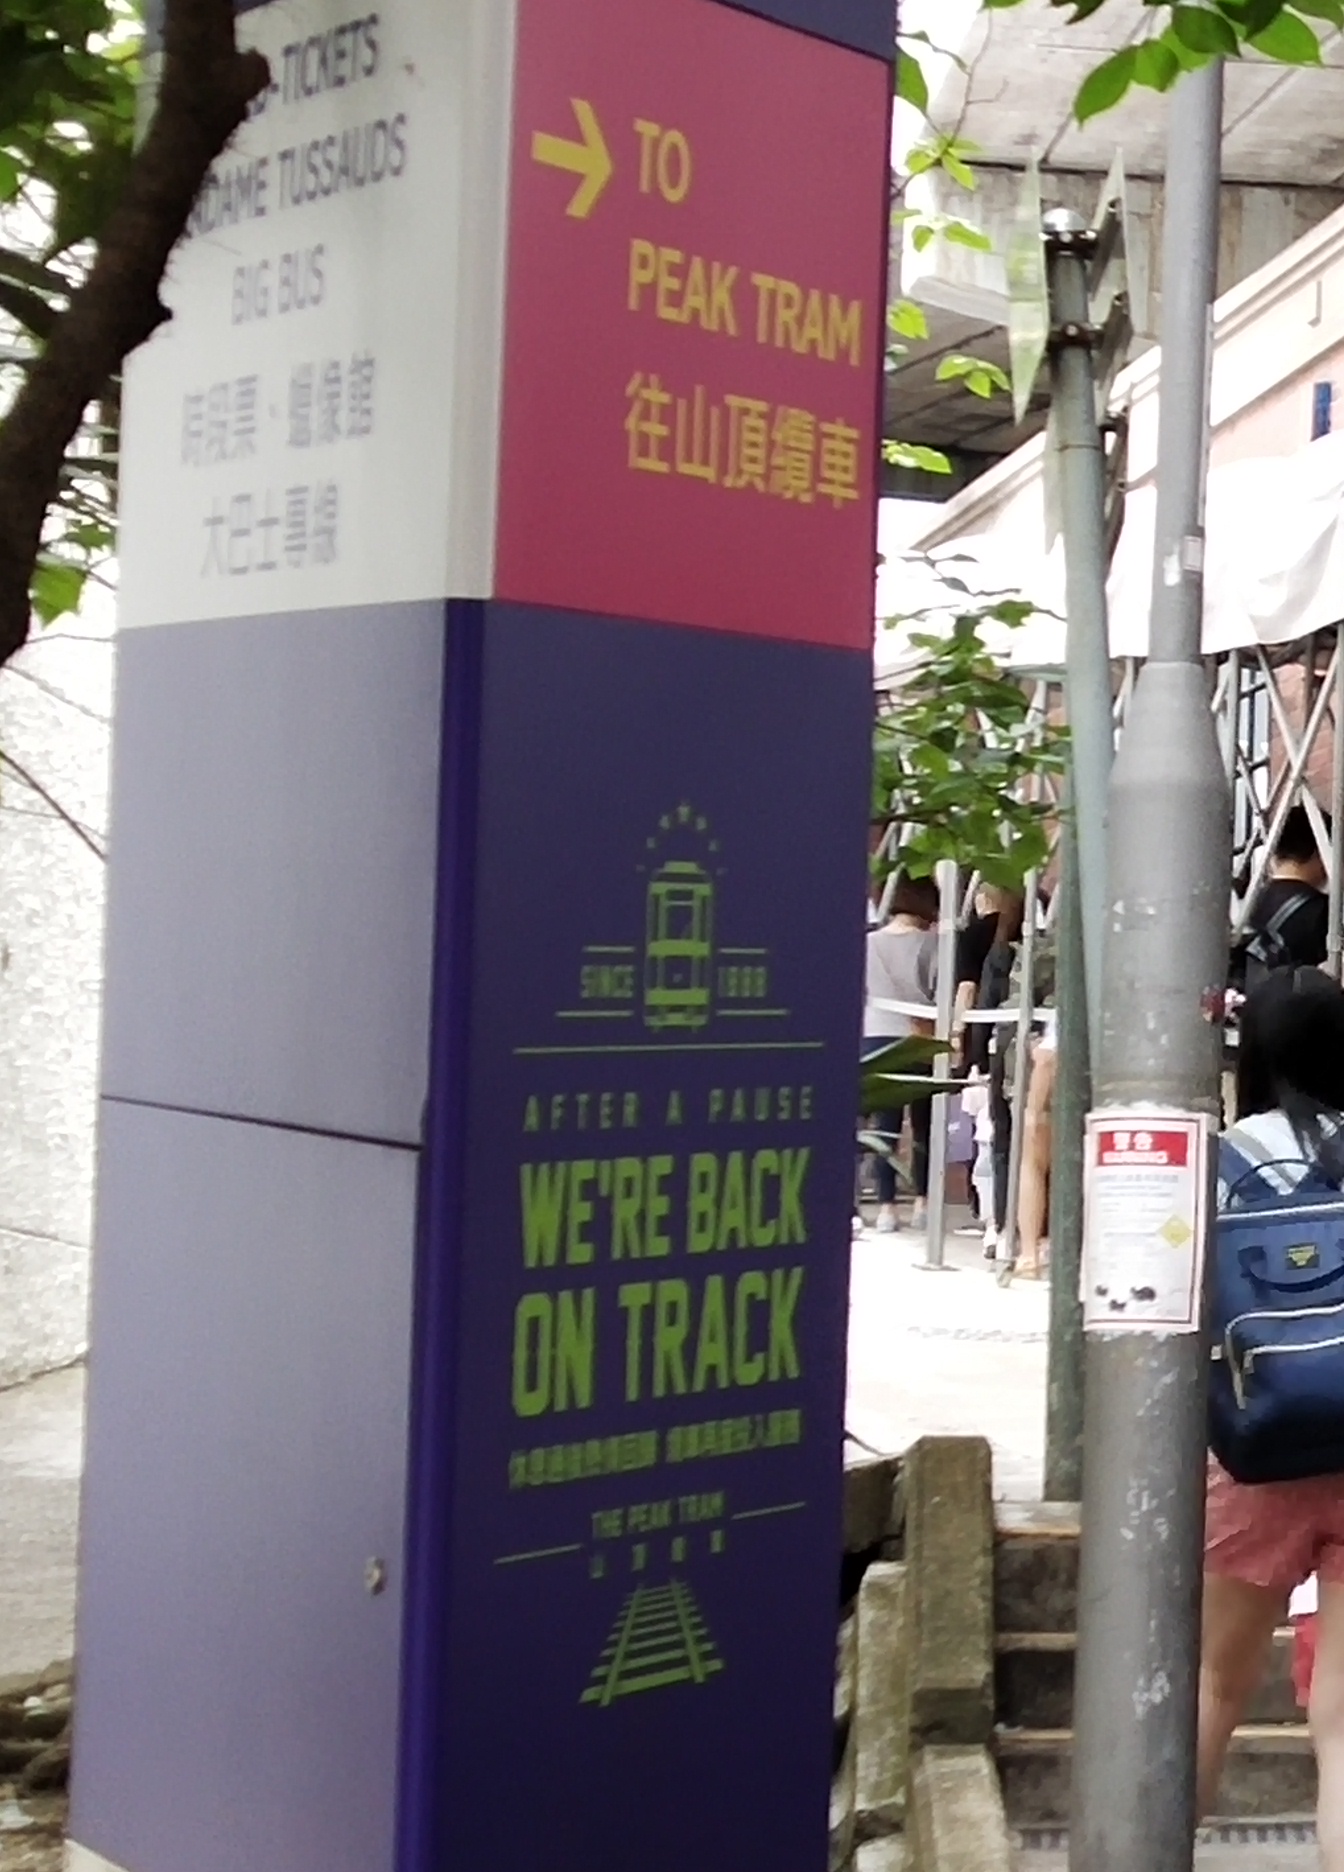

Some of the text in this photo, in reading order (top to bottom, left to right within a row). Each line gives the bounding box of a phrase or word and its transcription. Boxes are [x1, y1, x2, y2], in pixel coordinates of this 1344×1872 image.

[278, 113, 406, 211] TUSSAUDS
[633, 117, 690, 203] TO
[231, 244, 325, 325] BIG BUS
[628, 238, 861, 366] PEAK TRAM
[625, 372, 861, 508] 往山頂纜車
[580, 965, 634, 998] SINCE
[523, 1086, 812, 1132] AFTER A PAUSE
[520, 1146, 810, 1269] WE'RE BACK
[511, 1266, 804, 1417] ON TRACK
[591, 1490, 724, 1538] THE PEAK TRAM
